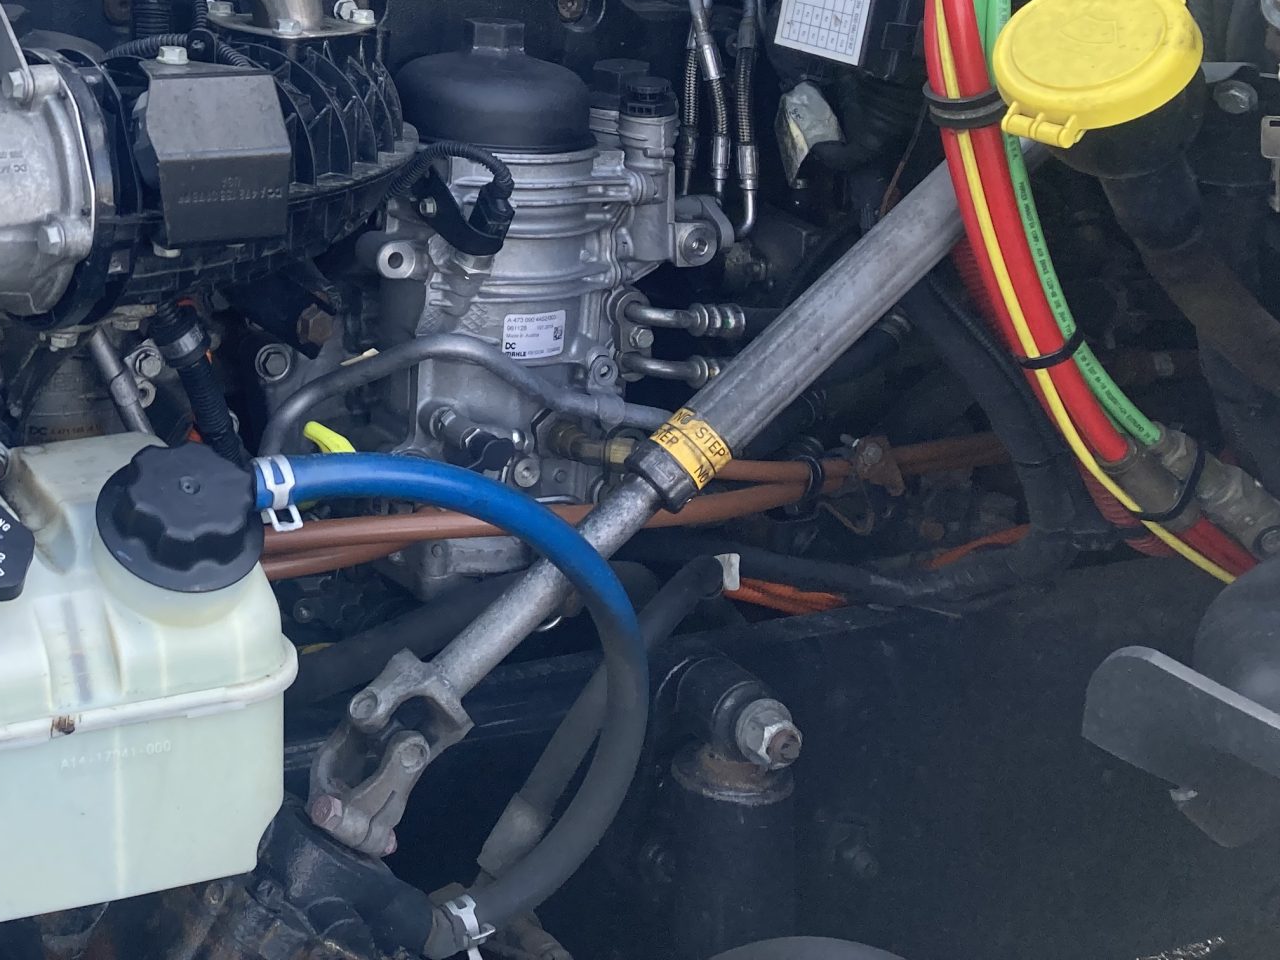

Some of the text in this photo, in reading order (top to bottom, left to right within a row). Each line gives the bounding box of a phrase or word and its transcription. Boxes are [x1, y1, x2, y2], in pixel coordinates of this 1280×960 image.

[505, 341, 516, 349] DC
[695, 426, 727, 459] STEP
[693, 464, 711, 485] NO
